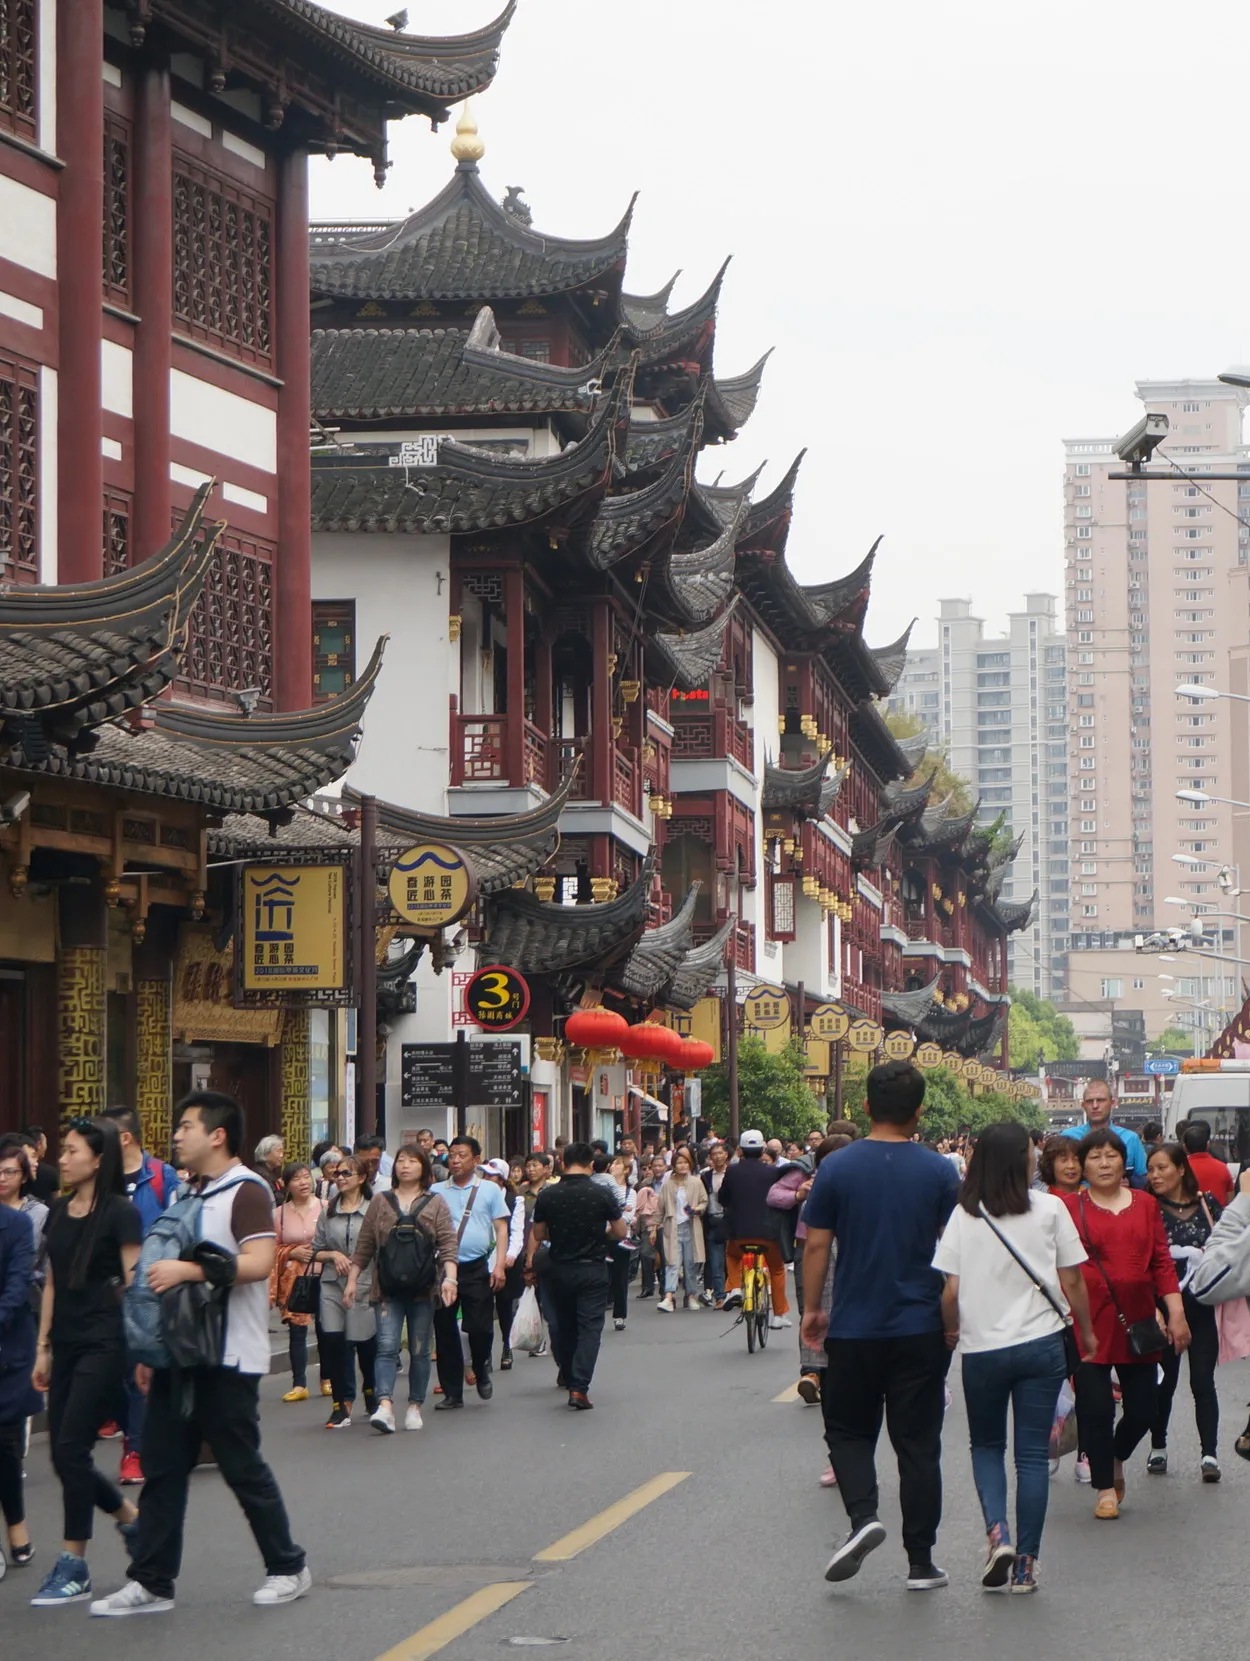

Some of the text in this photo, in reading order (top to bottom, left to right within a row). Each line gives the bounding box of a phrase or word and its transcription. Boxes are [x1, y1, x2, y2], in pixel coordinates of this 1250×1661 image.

[407, 875, 452, 889] 春游园
[407, 889, 452, 901] 匠心茶
[478, 972, 510, 1008] 3
